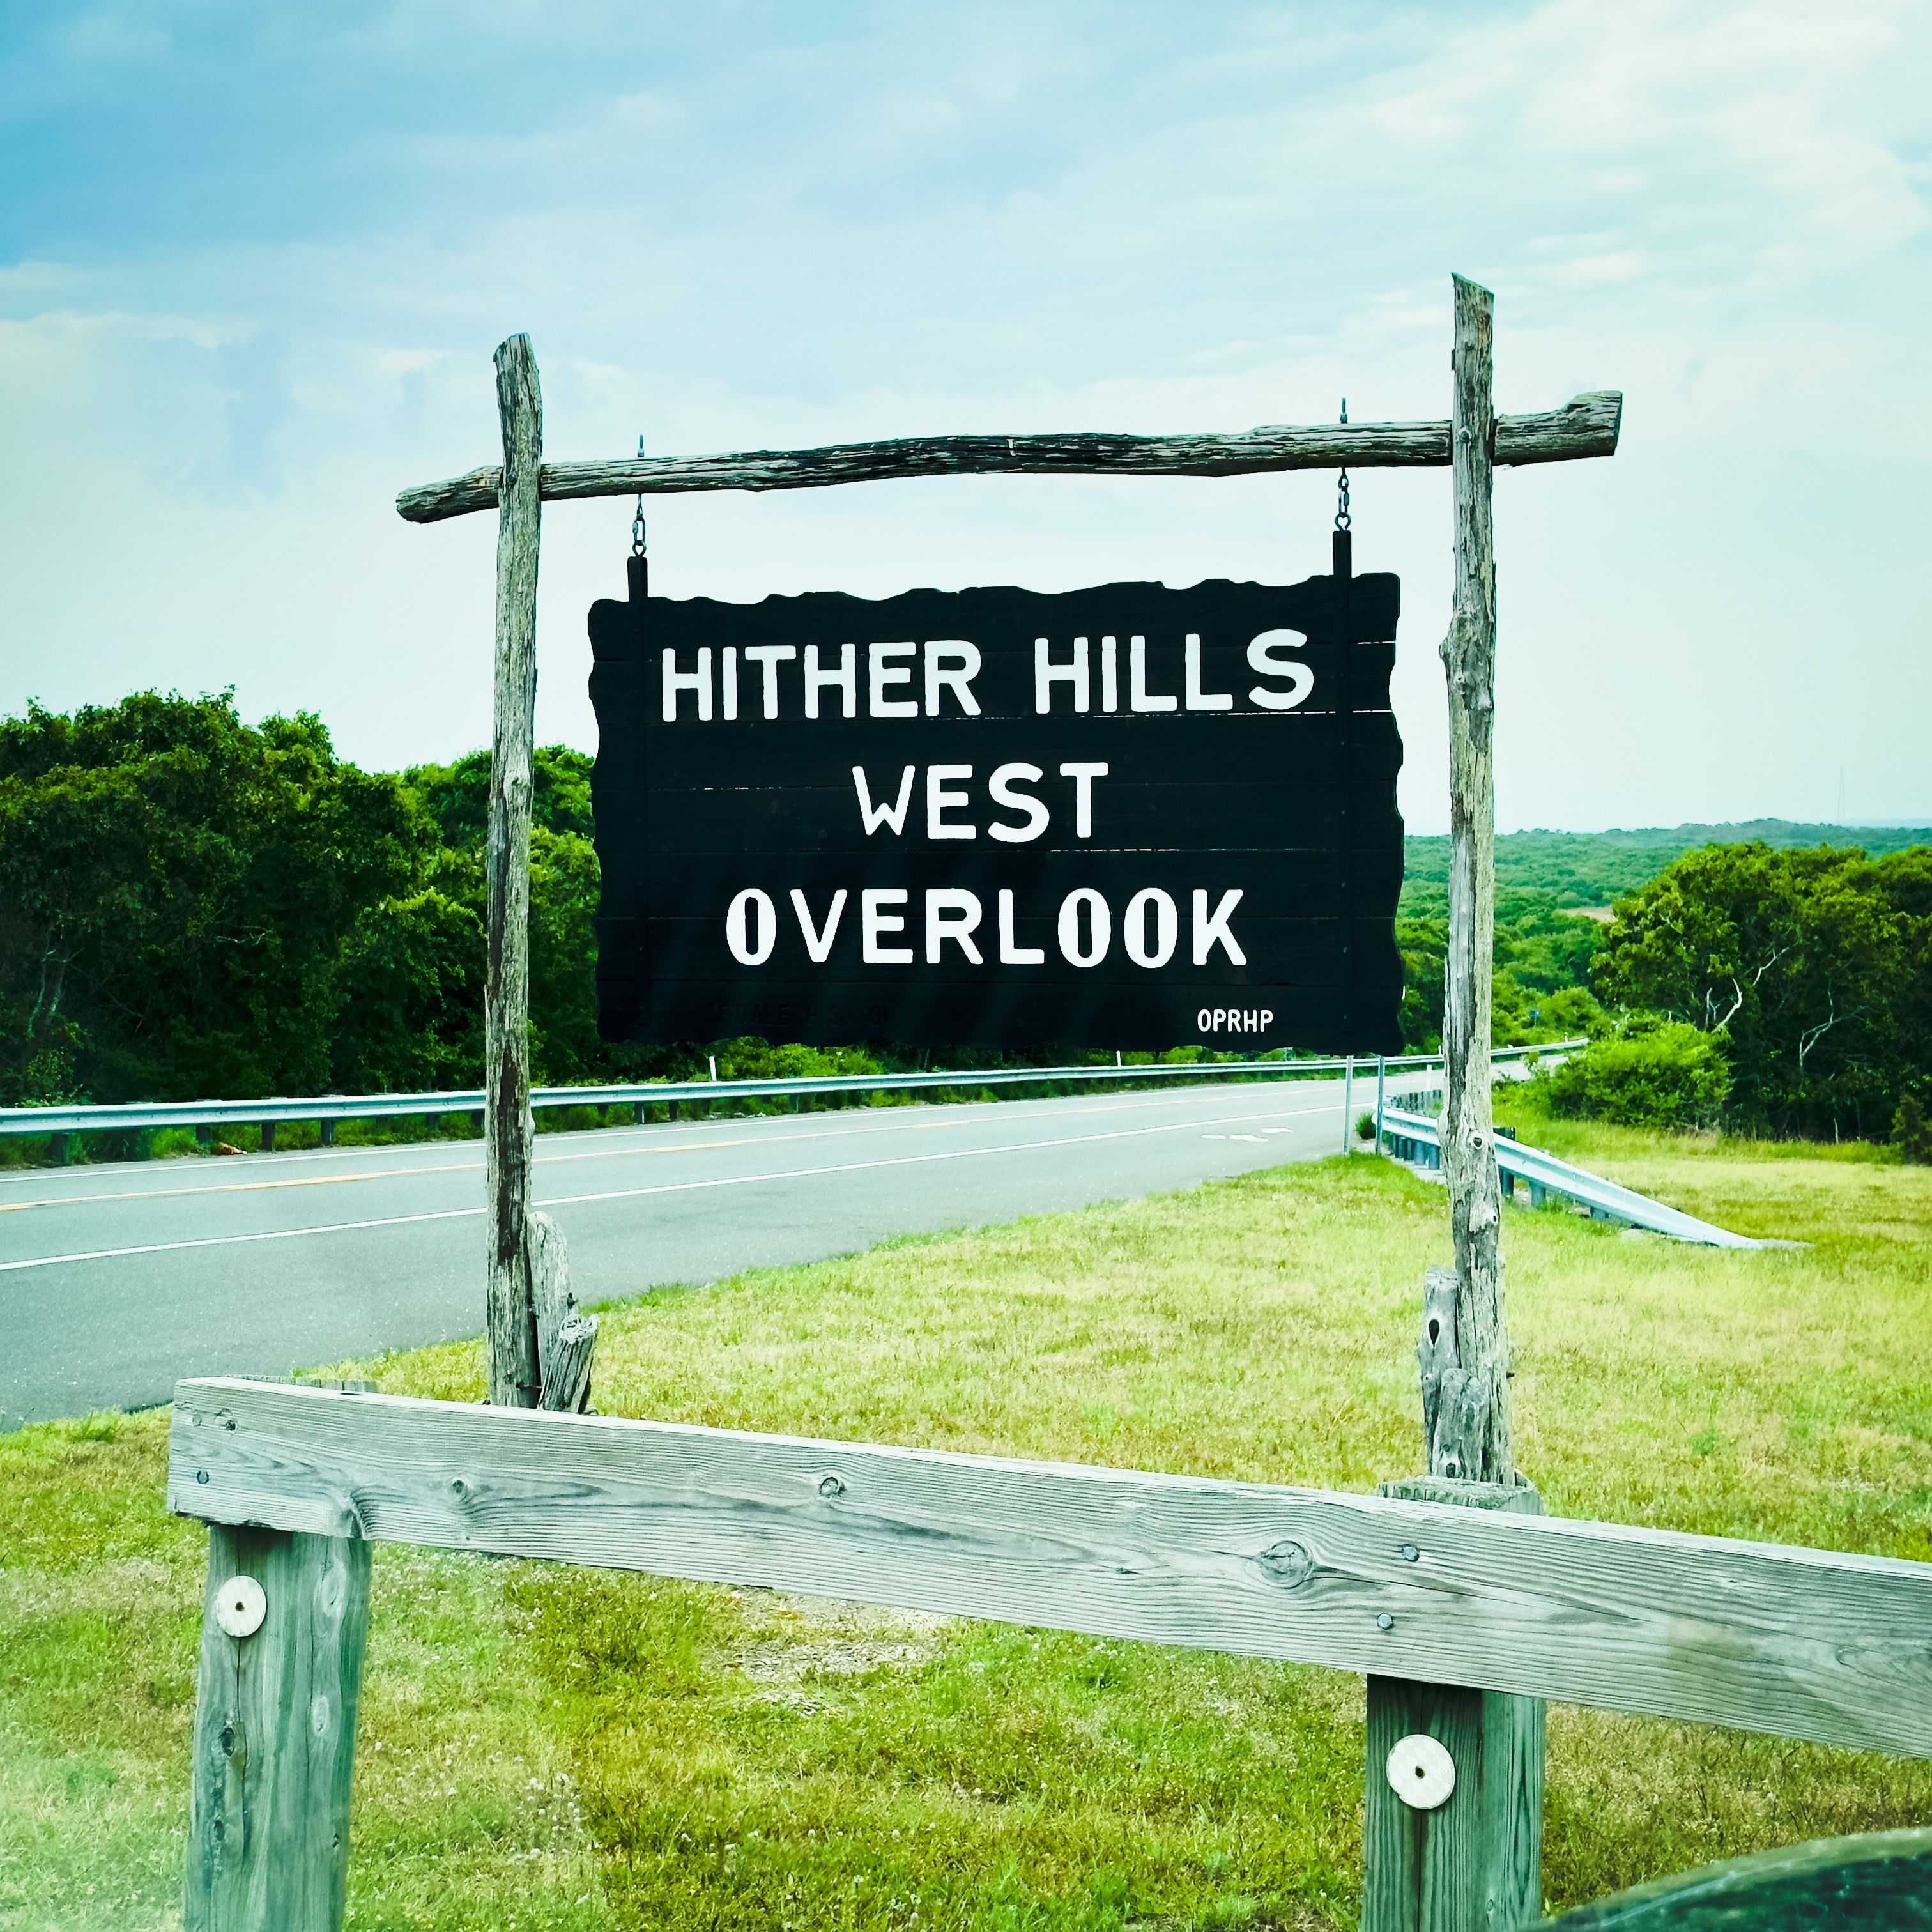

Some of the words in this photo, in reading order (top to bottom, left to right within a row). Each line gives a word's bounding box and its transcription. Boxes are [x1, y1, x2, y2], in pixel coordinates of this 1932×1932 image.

[662, 640, 981, 723] HITHER
[1034, 629, 1314, 714] HILLS
[852, 762, 1109, 843] WEST
[726, 887, 1247, 969] OVERLOOK
[1197, 1008, 1274, 1033] OPRHP
